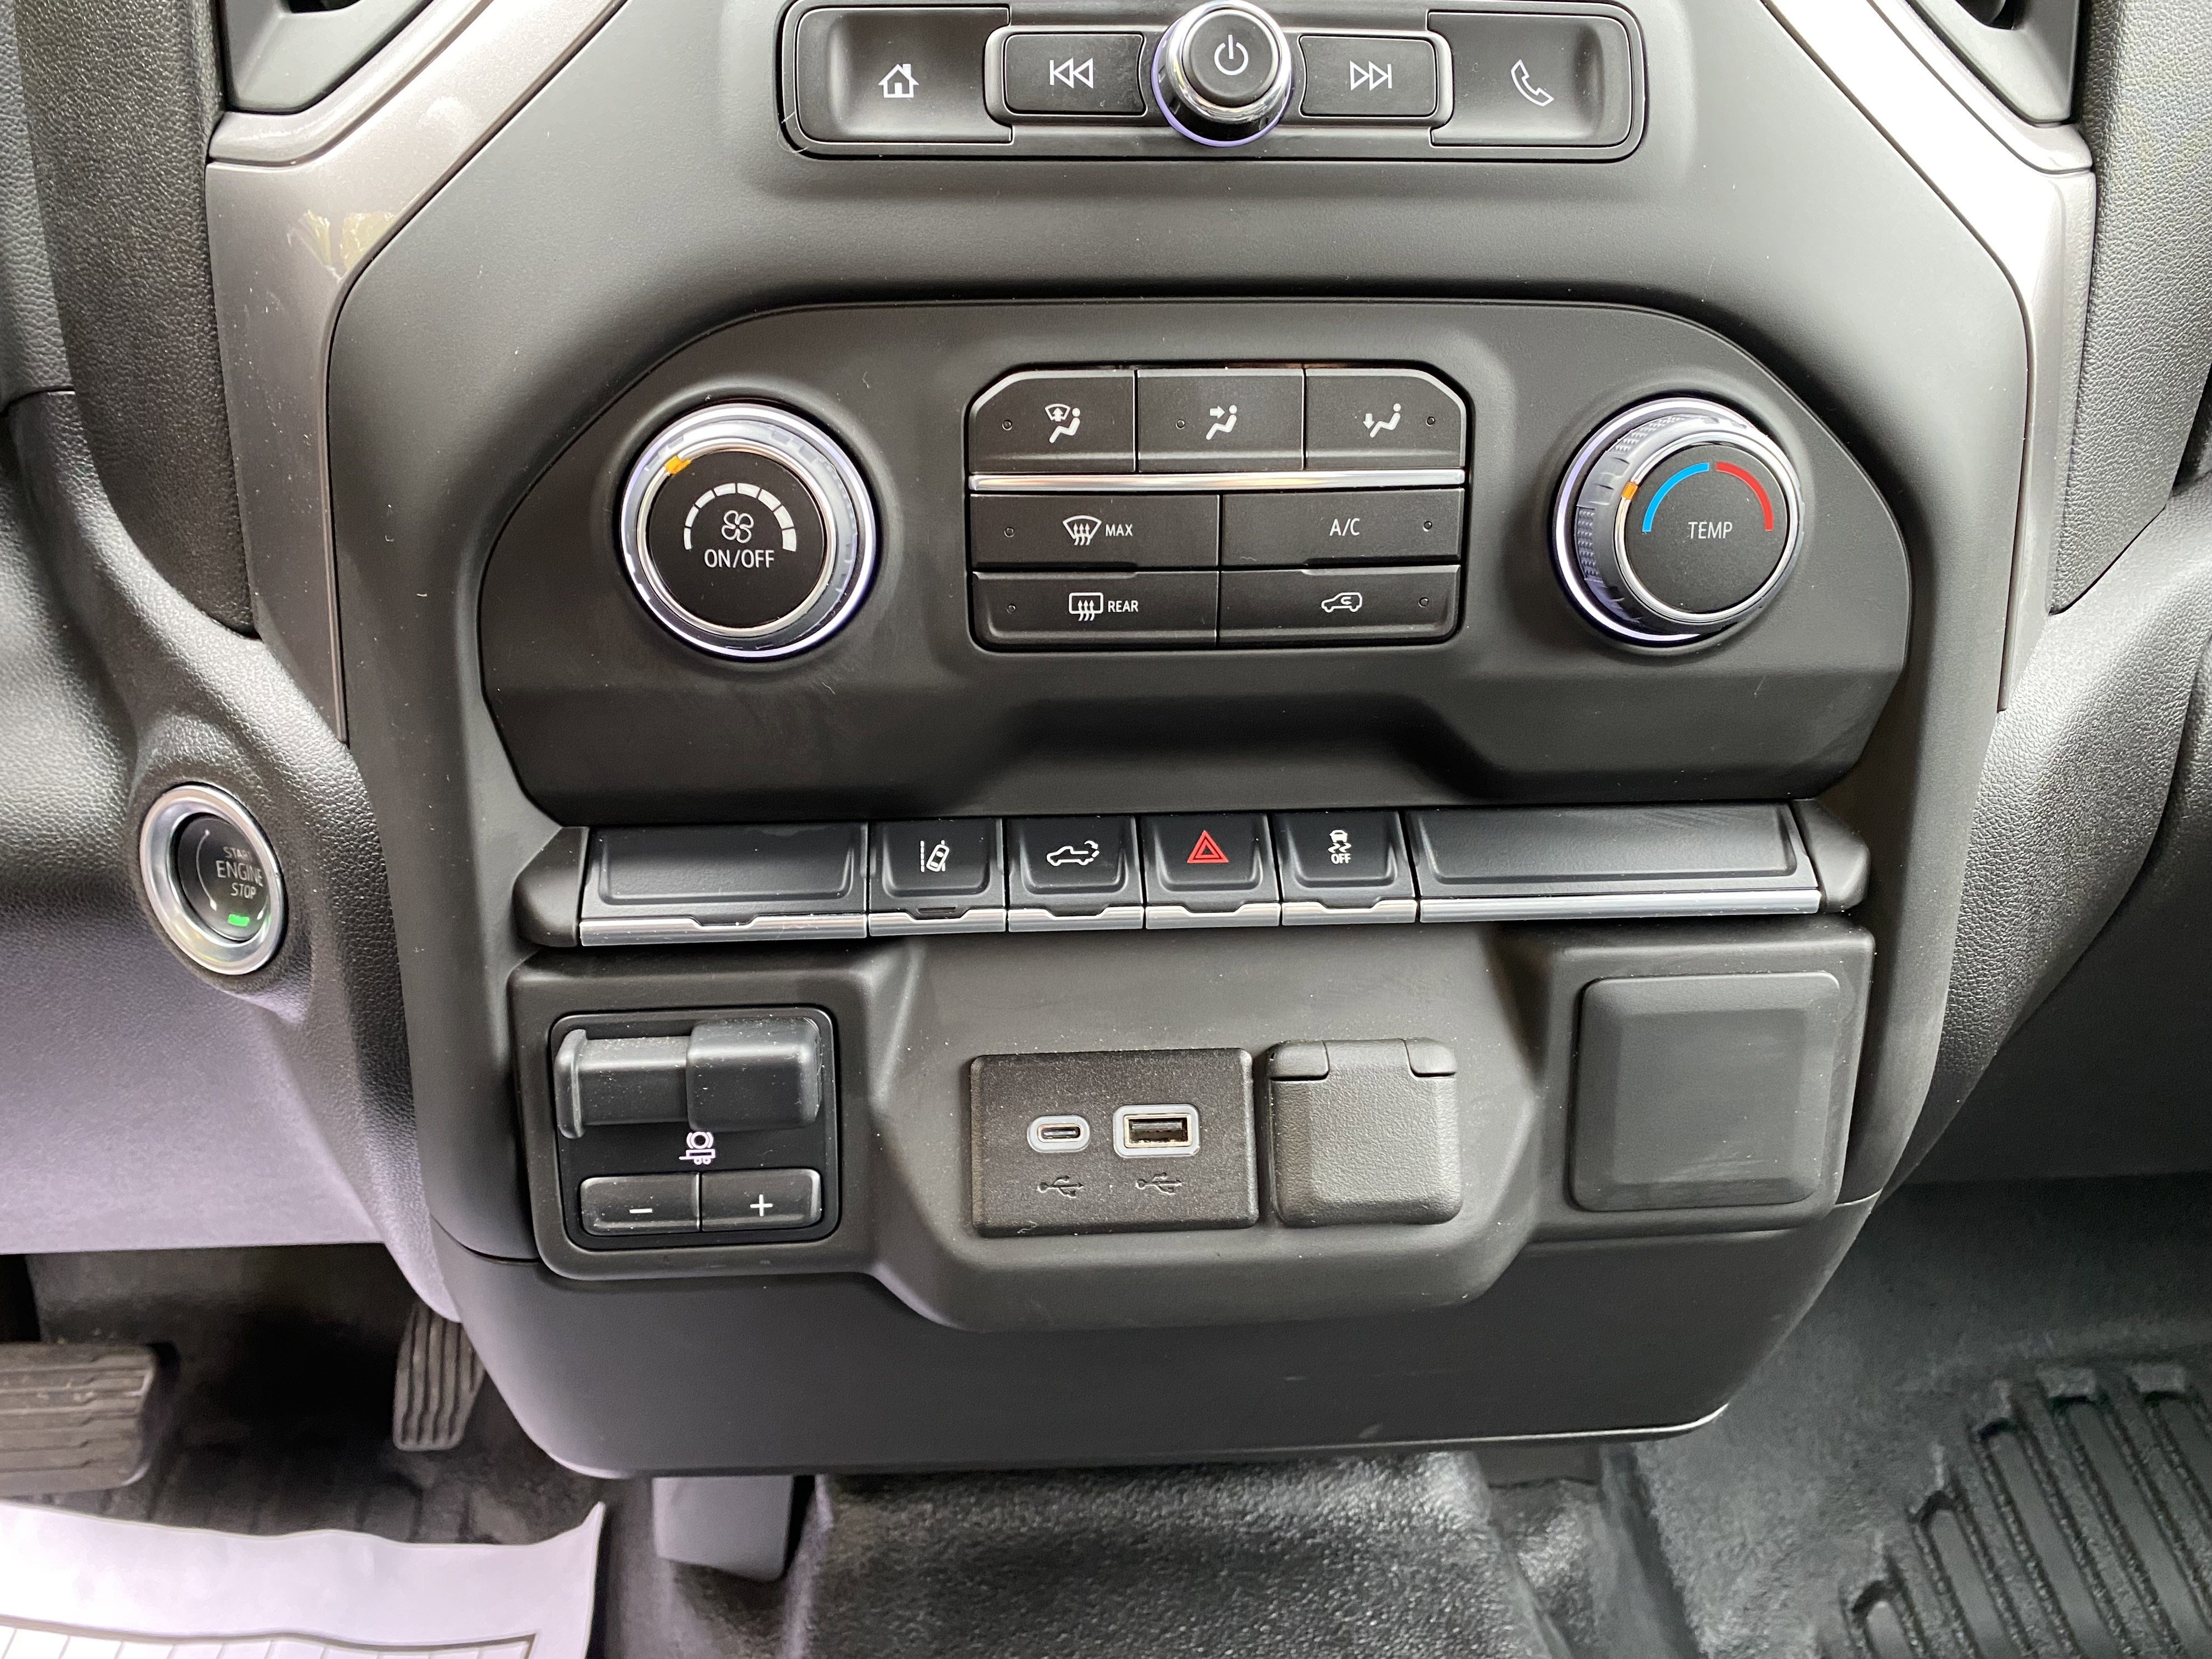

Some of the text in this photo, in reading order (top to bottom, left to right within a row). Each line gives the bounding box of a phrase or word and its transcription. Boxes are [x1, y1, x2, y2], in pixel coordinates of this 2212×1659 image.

[1105, 523, 1133, 538] MAX
[1329, 518, 1361, 537] A/C
[1688, 521, 1733, 539] TEMP
[704, 549, 775, 568] ON/OFF
[1107, 600, 1139, 614] REAR
[1331, 853, 1351, 865] OFF
[216, 860, 263, 887] ENGINE
[230, 882, 257, 899] STOP
